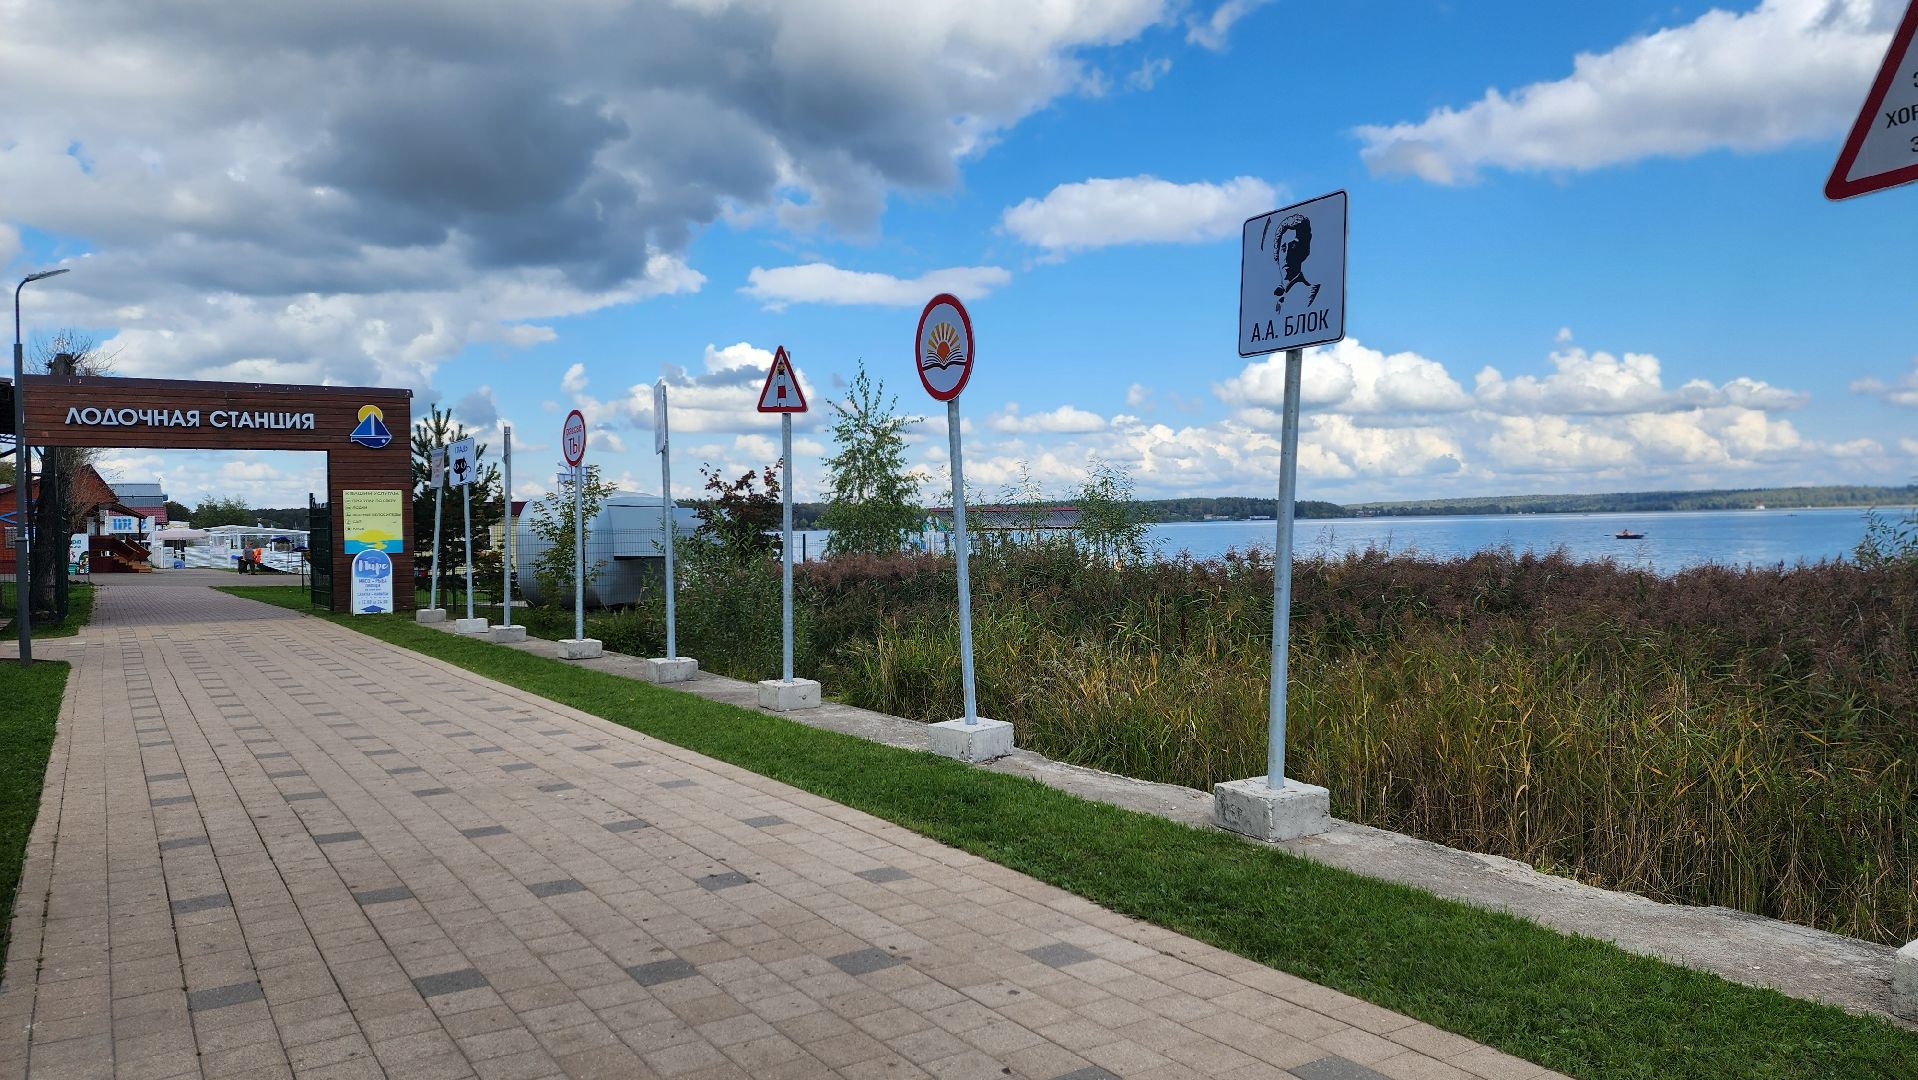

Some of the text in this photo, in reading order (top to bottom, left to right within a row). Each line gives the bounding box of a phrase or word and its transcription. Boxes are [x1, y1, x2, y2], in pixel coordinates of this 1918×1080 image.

[1251, 309, 1329, 342] А.А. БЛОК
[65, 407, 315, 430] ЛОДОЧНАЯ СТАНЦИЯ
[568, 435, 580, 455] ТЫ
